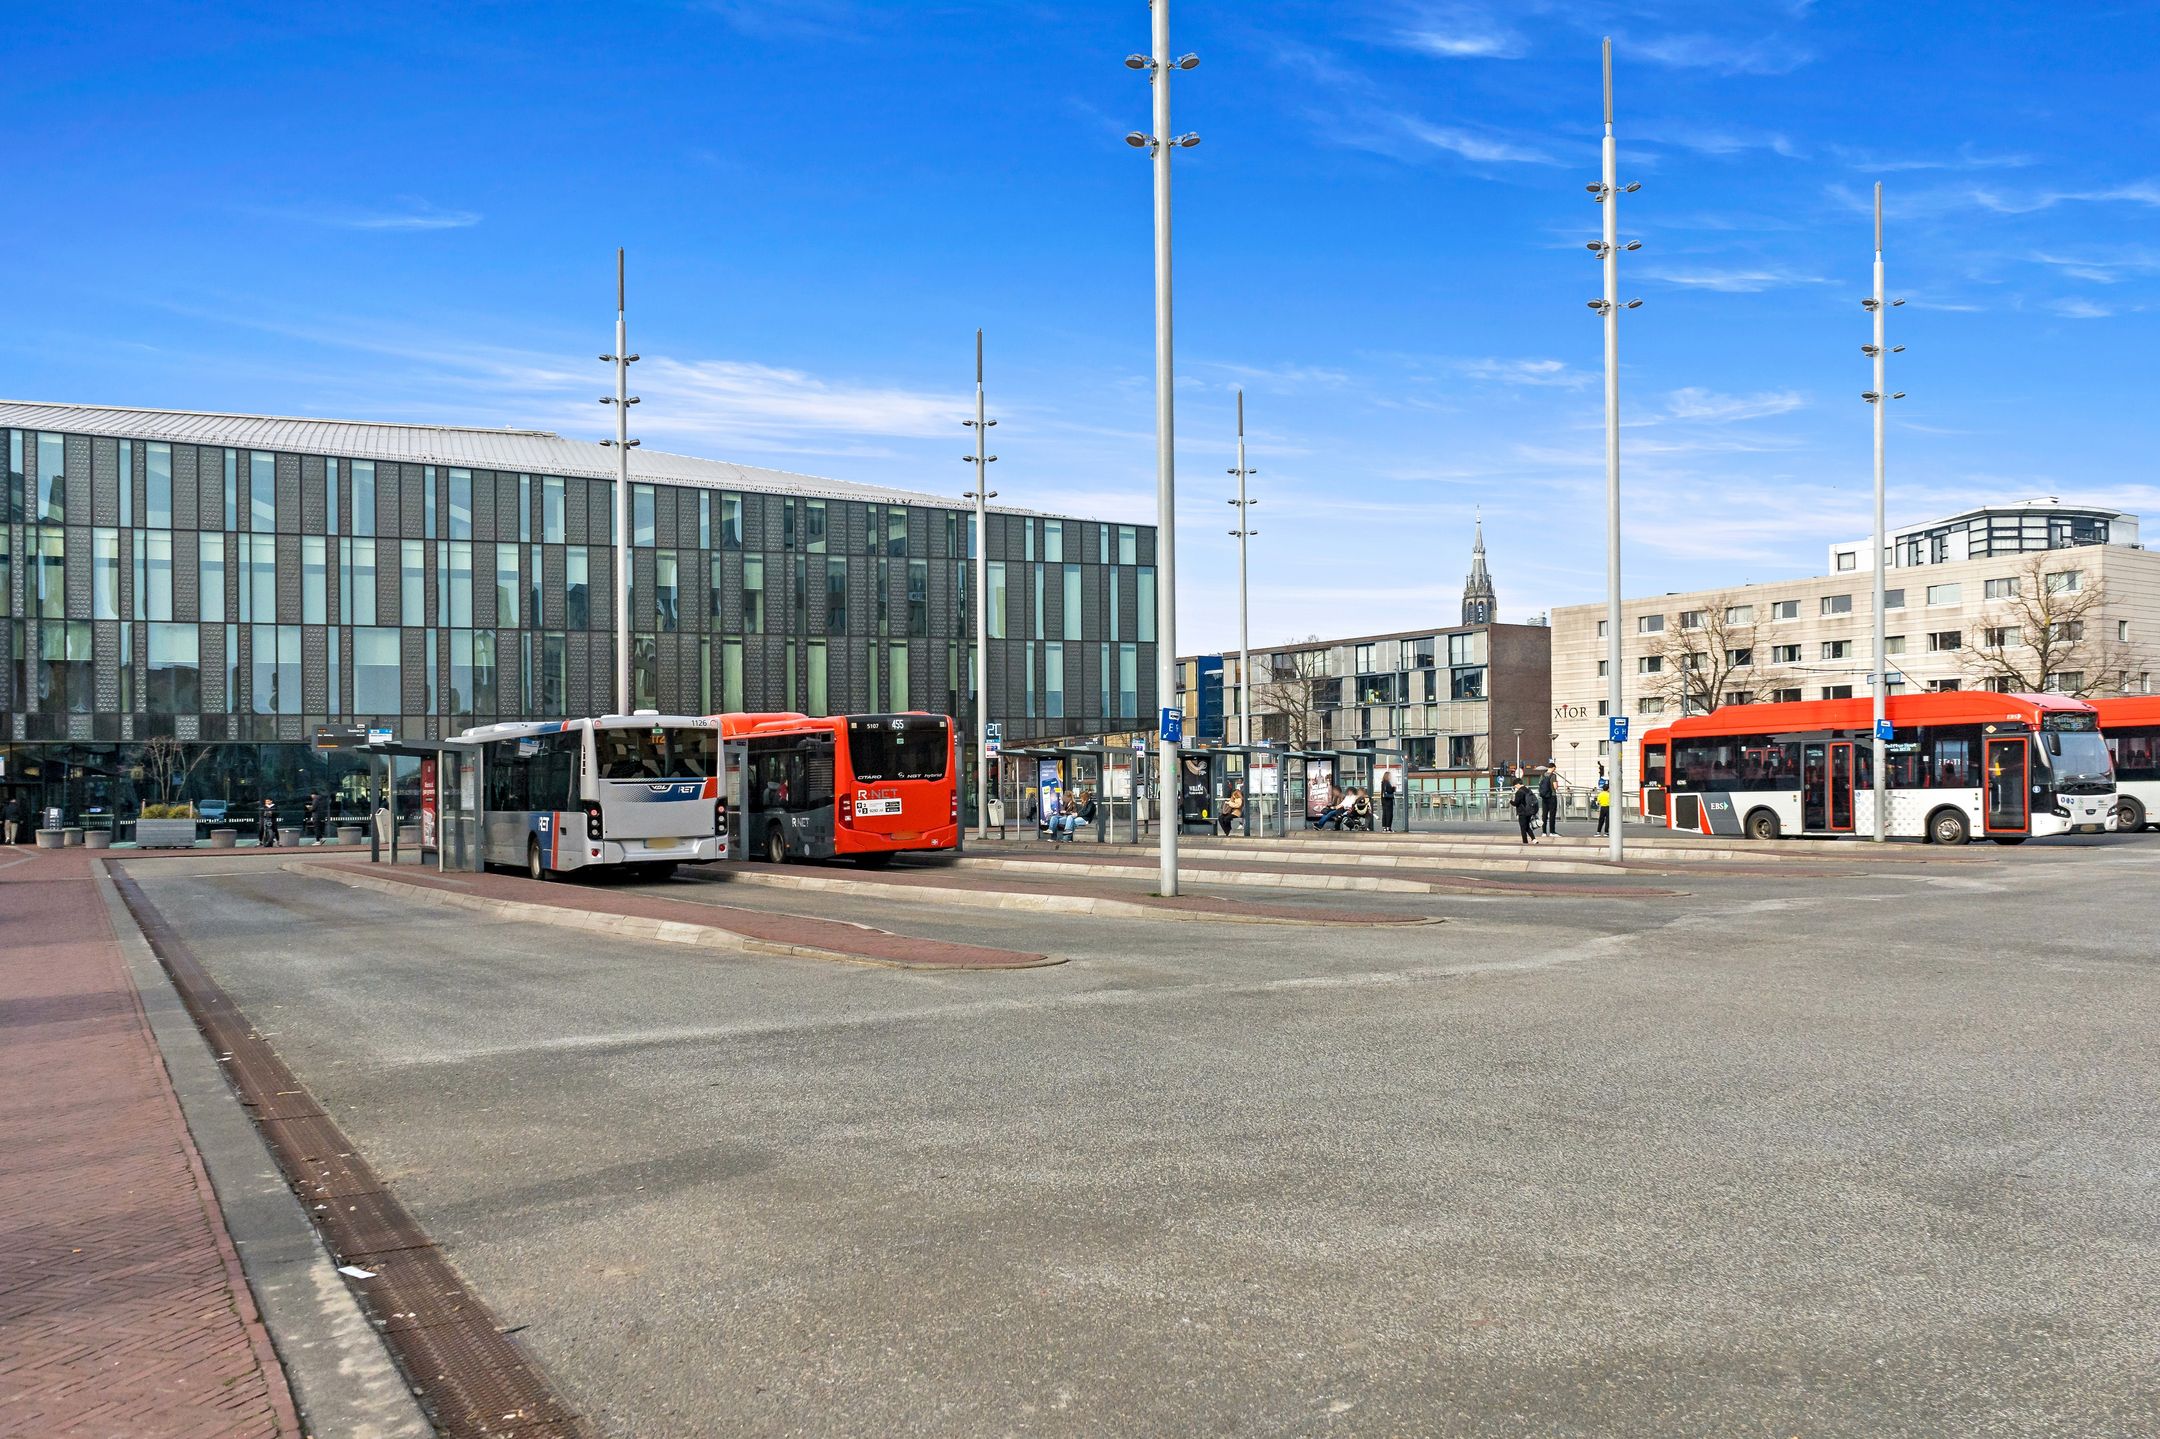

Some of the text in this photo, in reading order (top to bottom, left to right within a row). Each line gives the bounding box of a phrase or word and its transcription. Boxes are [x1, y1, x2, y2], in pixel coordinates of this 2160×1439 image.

[1554, 706, 1588, 718] XIOR
[891, 720, 904, 729] 455
[1169, 723, 1174, 732] E
[538, 816, 550, 832] RET
